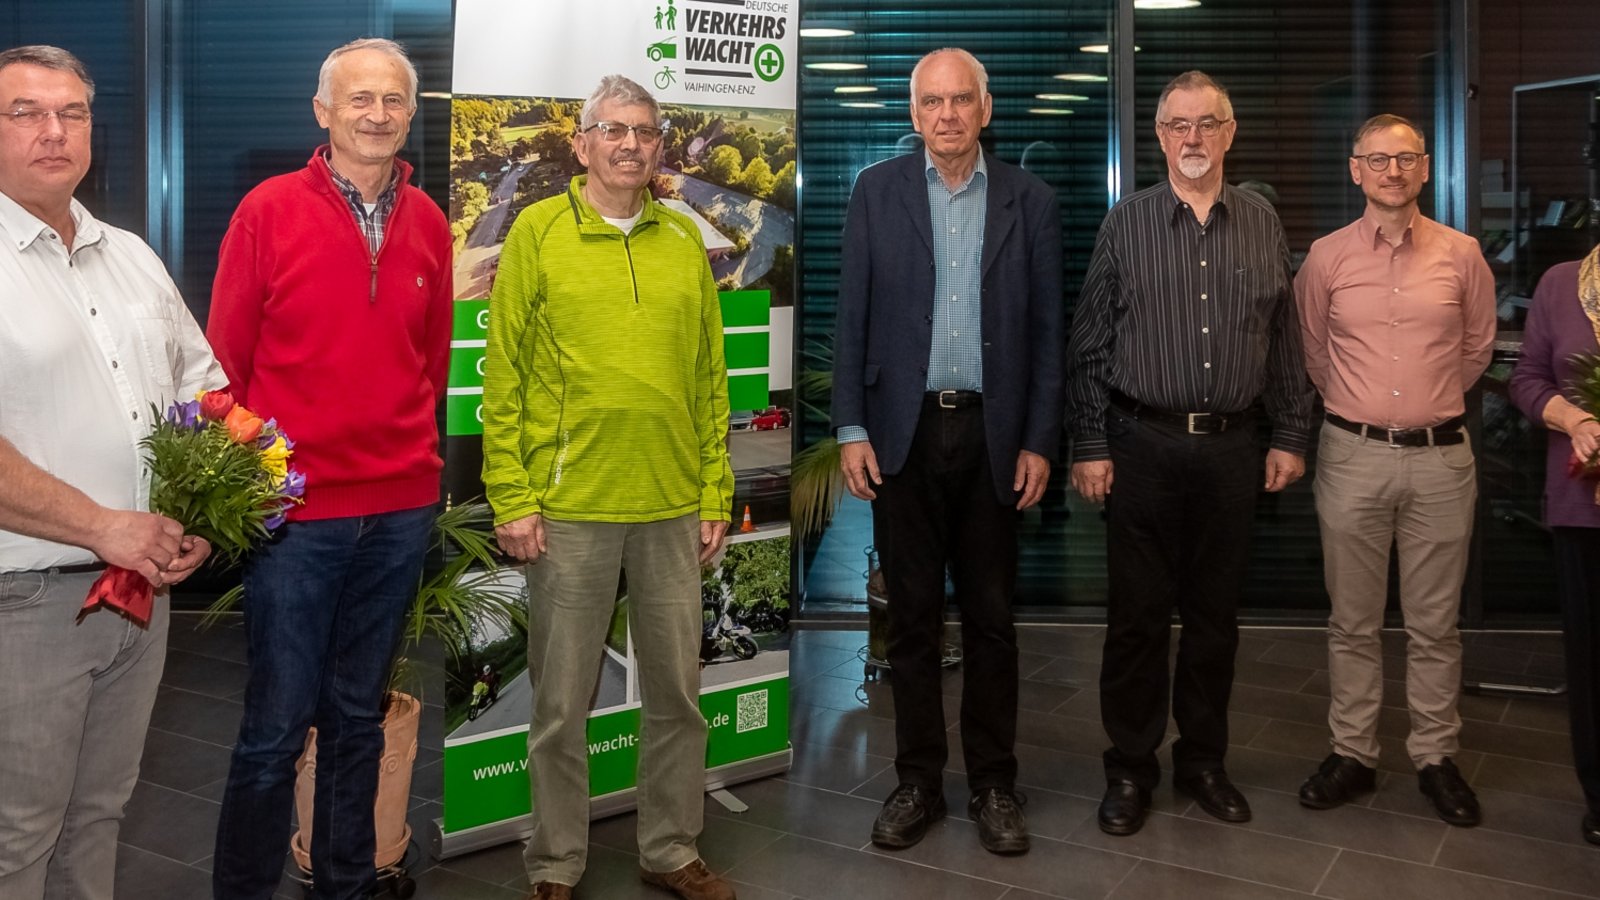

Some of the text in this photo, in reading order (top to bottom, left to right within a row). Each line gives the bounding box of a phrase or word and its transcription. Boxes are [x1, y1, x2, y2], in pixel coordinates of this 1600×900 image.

[745, 0, 789, 13] DEUTSCHE
[685, 8, 787, 40] VERKEHRS
[685, 37, 755, 65] WACHT
[684, 82, 756, 95] VAIHINGEN-ENZ
[473, 711, 730, 781] www.v wacht- .de
